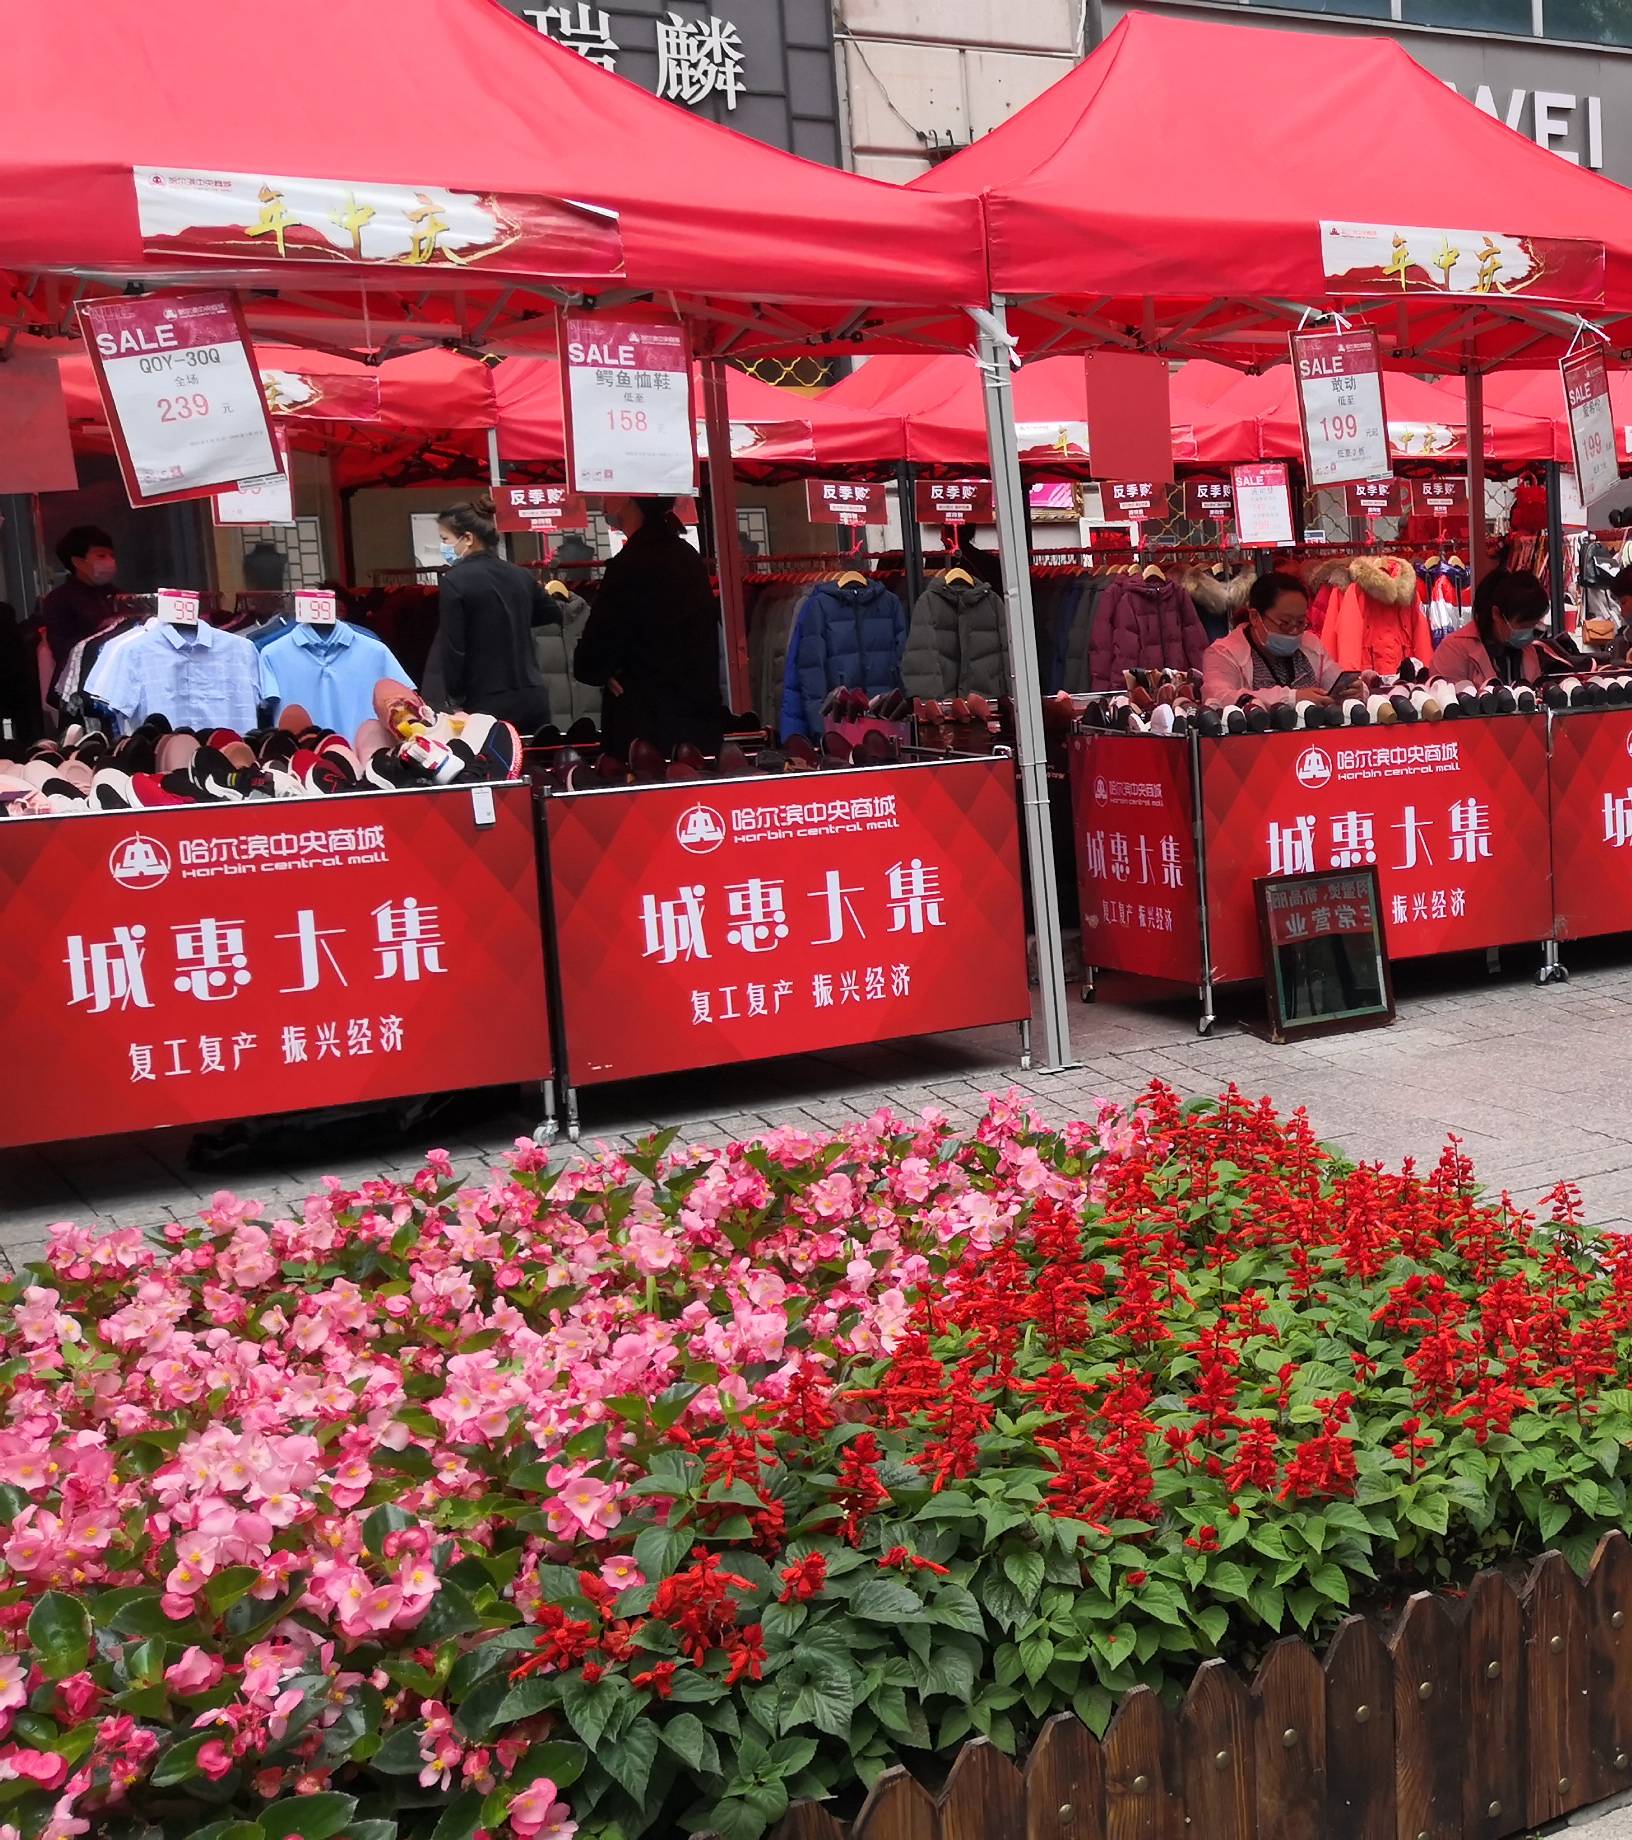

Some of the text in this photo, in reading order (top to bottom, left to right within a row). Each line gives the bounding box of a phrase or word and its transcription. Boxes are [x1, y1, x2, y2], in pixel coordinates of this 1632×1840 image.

[96, 324, 178, 355] SALE
[568, 343, 636, 366] SALE
[1300, 356, 1345, 377] SALE
[174, 374, 199, 388] 全场
[595, 369, 672, 390] 鳄鱼恤鞋
[1569, 382, 1591, 405] SALE
[157, 394, 209, 423] 239
[607, 409, 648, 431] 158
[1320, 414, 1357, 441] 199
[1582, 431, 1602, 462] 199
[823, 485, 870, 501] 反季购
[931, 485, 978, 501] 反季购
[1235, 476, 1264, 487] SALE
[510, 488, 565, 506] 反季购
[174, 600, 195, 620] 99
[310, 600, 331, 620] 99
[1338, 742, 1458, 770] 哈尔滨中央商城
[1338, 762, 1461, 781] Harbin central mall
[732, 795, 897, 831] 哈尔滨中央商城
[733, 816, 900, 844] Harbin central mall
[1265, 797, 1494, 875] 城惠大集
[180, 825, 386, 865] 哈尔滨中央商城
[182, 851, 389, 879] Harbin central mall
[1087, 831, 1183, 888] 城惠大集
[639, 858, 946, 964] 城惠大集
[1102, 900, 1173, 933] 复工复产 振兴经济
[1392, 888, 1466, 925] 振兴经济
[62, 897, 449, 1013] 城惠大集
[691, 964, 910, 1025] 复工复产 振兴经济
[129, 1015, 403, 1082] 复工复产 振兴经济
